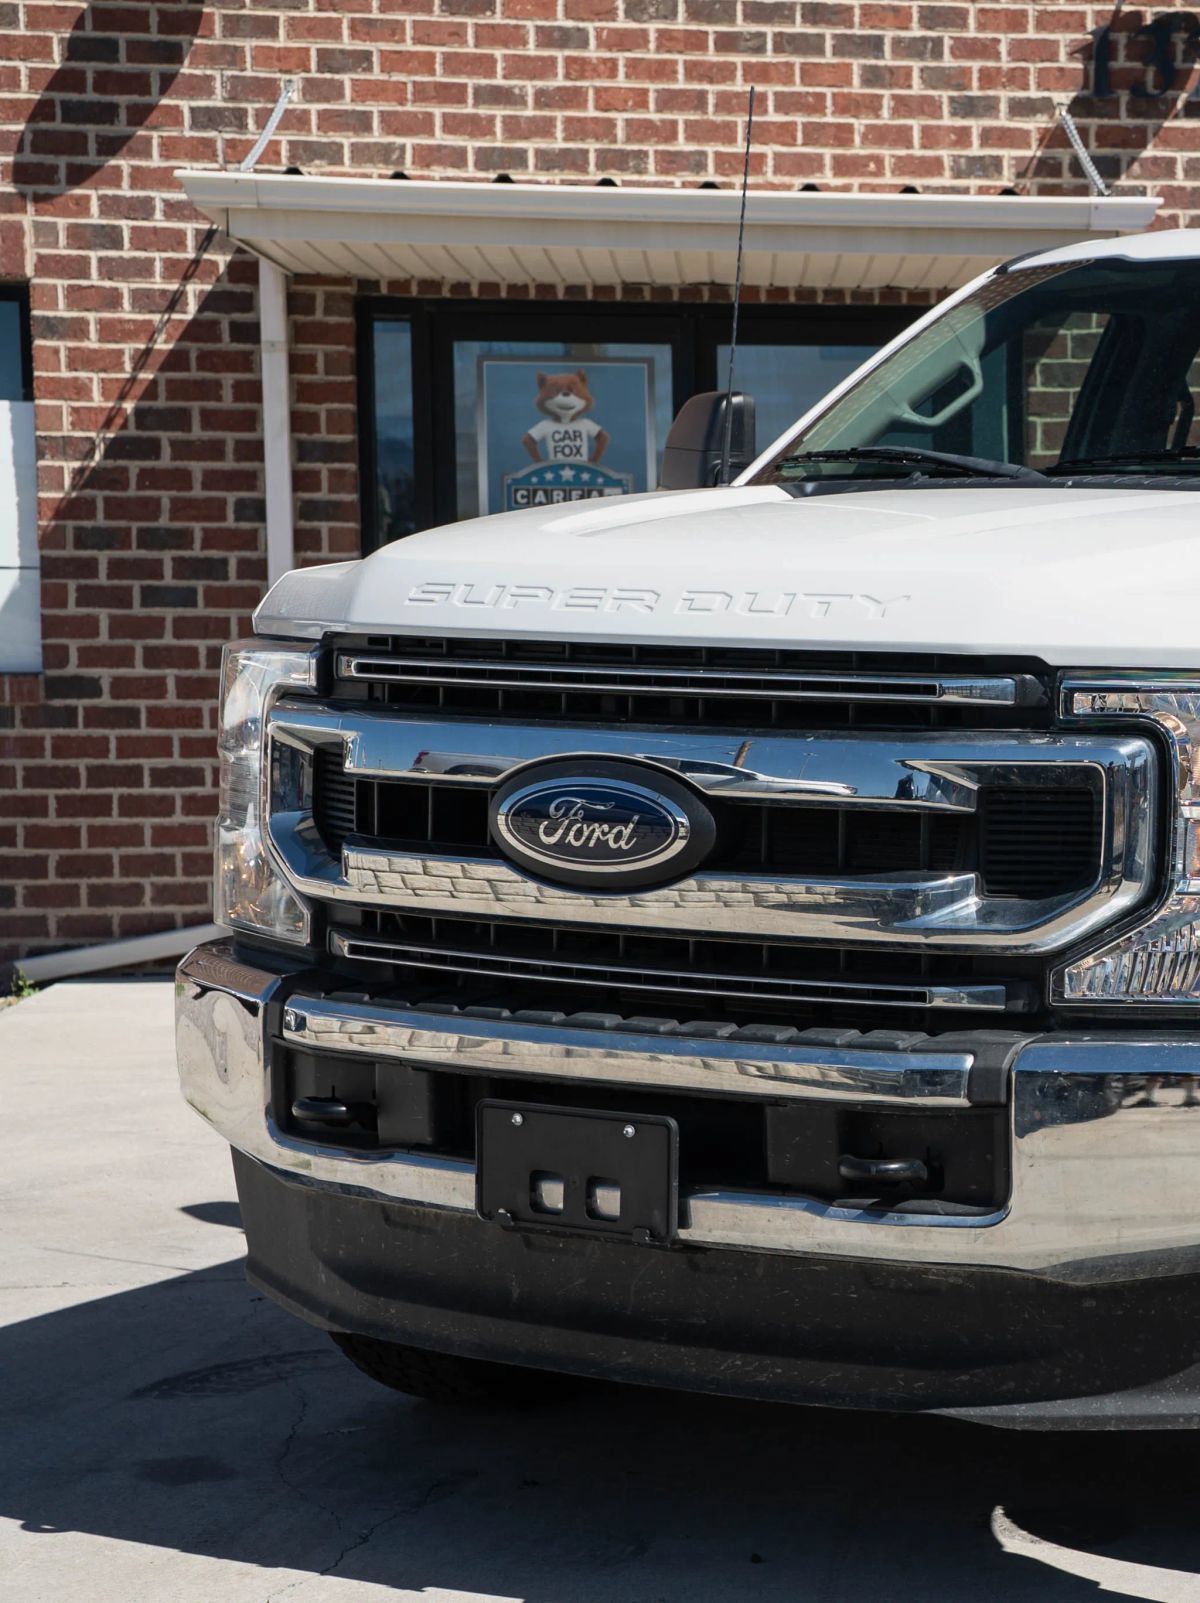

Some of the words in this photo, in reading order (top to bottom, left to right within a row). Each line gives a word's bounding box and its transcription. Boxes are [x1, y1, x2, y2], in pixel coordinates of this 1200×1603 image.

[551, 430, 583, 443] CAR
[553, 444, 583, 458] FOX
[405, 582, 661, 613] SUPER
[674, 590, 911, 619] DUTY
[539, 797, 639, 850] Ford
